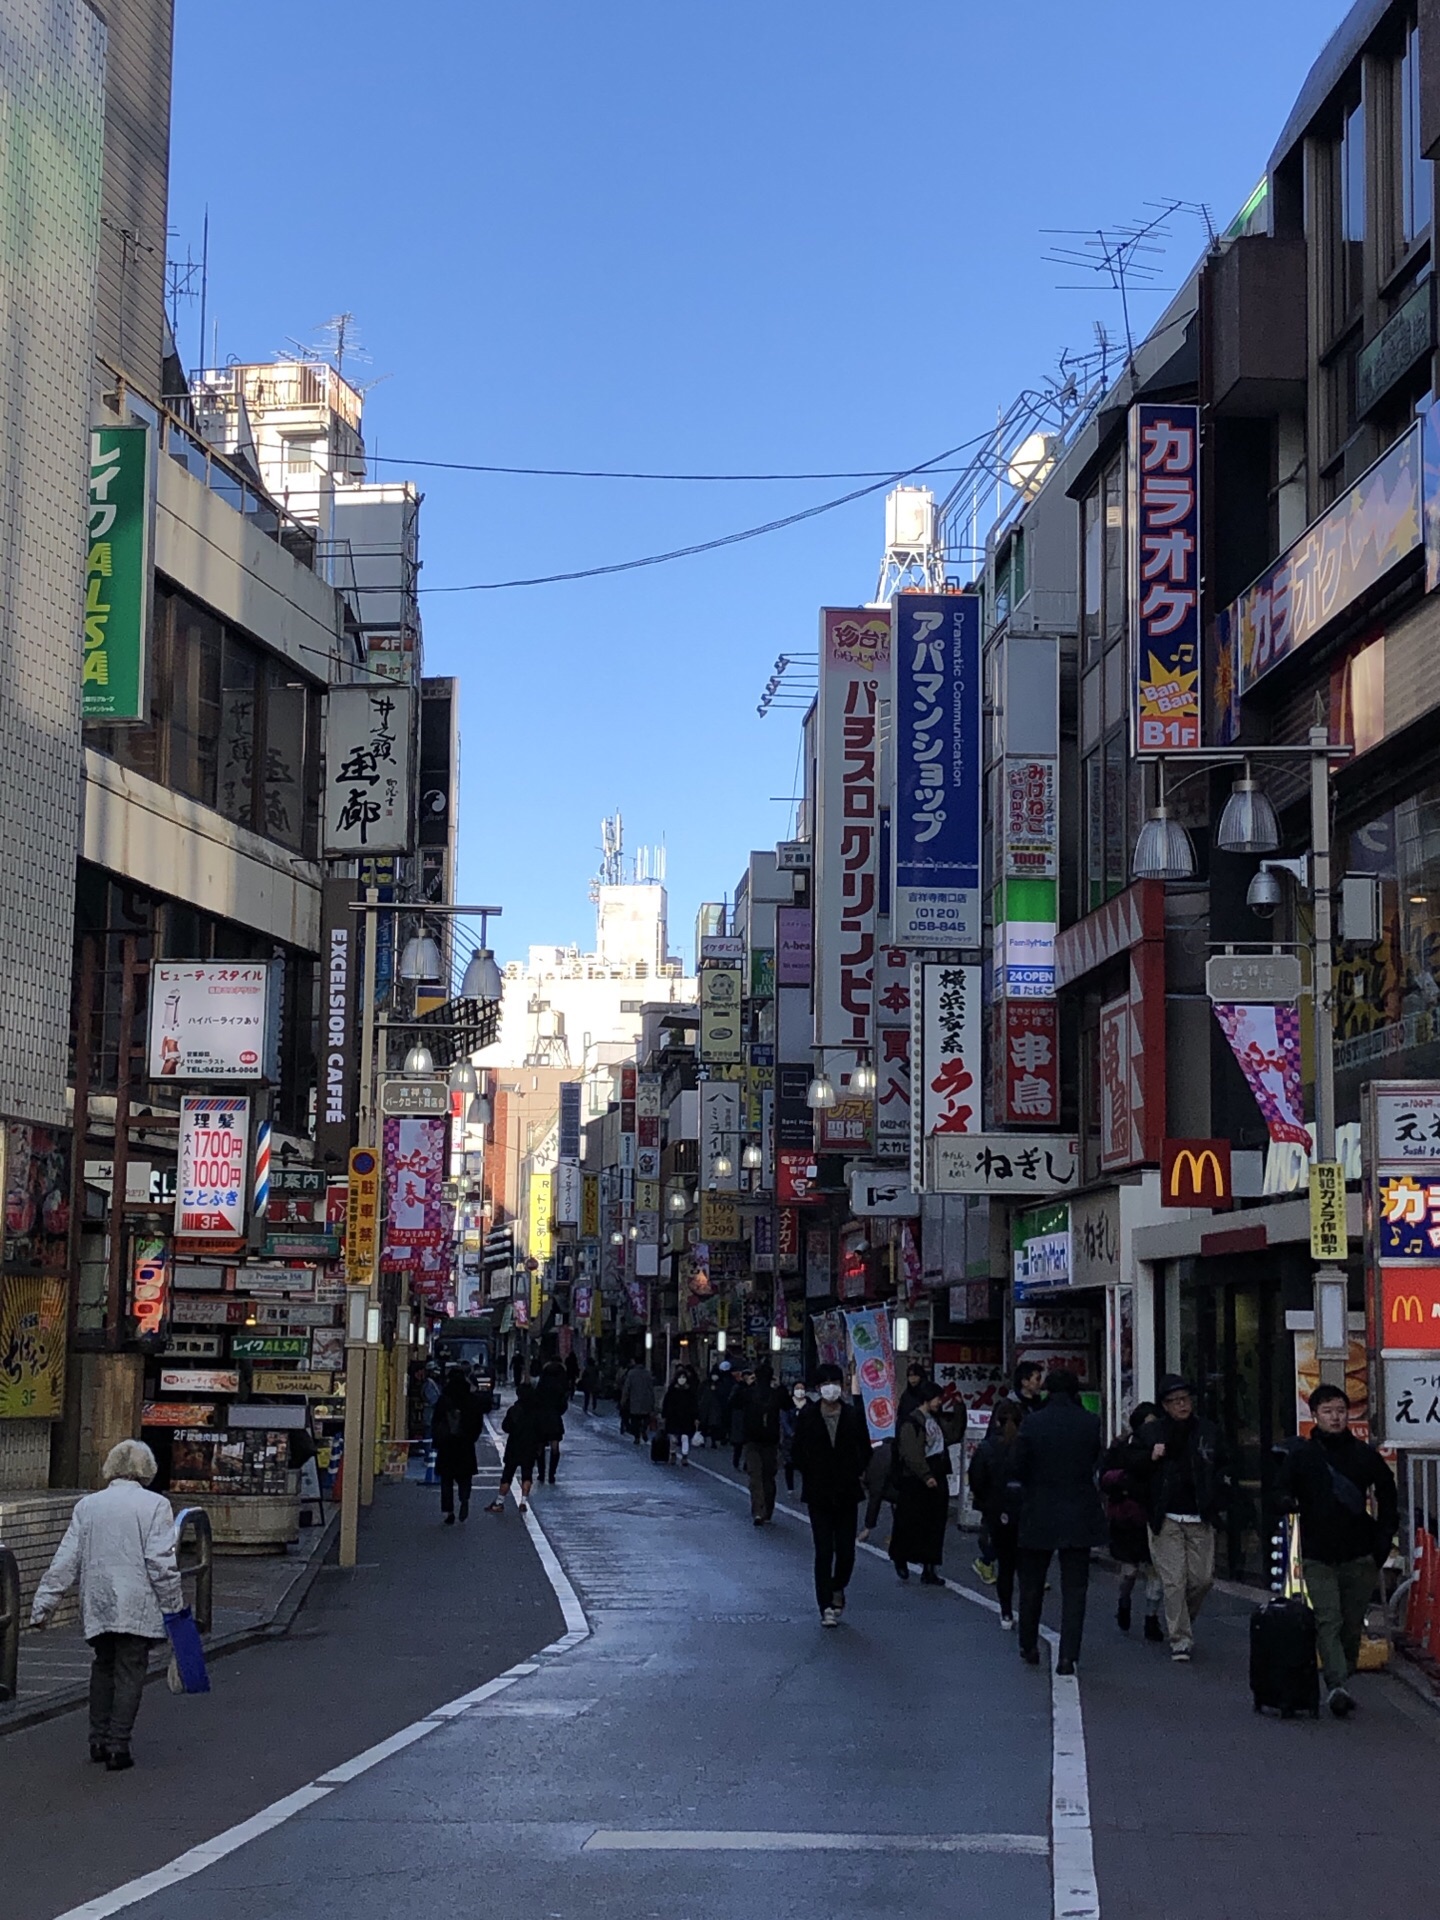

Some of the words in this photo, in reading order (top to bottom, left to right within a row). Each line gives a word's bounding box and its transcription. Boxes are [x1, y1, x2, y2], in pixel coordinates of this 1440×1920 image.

[1141, 420, 1195, 637] カラオケ
[1250, 516, 1347, 673] カラオケ
[952, 612, 966, 678] Dramatic
[1143, 679, 1180, 701] Ban
[1157, 690, 1195, 714] Ban
[912, 610, 948, 843] アパマンショップ
[952, 680, 966, 788] Communication
[1142, 721, 1196, 747] B1F
[1028, 764, 1045, 834] みけねこ
[908, 892, 967, 904] 吉祥寺南口店
[915, 908, 960, 919] (0120)
[909, 920, 967, 932] 058-845
[703, 943, 743, 952] イケダビル
[1009, 938, 1053, 949] FamilyMart
[327, 928, 348, 1047] EXCELSIOR
[1010, 985, 1021, 996] 酒
[1024, 985, 1054, 996] たばこ
[1009, 1030, 1053, 1117] 串鳥
[325, 1059, 347, 1125] CAFFÉ
[400, 1087, 432, 1097] 吉祥寺
[193, 1113, 236, 1130] 理髪
[827, 1120, 864, 1140] 聖地
[194, 1131, 243, 1159] 1700円
[1403, 1144, 1428, 1157] Sushi
[192, 1160, 241, 1189] 1000円
[974, 1145, 1075, 1185] ねぎし
[182, 1190, 239, 1207] ことぶき
[200, 1214, 221, 1230] 3F
[1318, 1167, 1338, 1256] 防犯カメラ作動中
[233, 1339, 299, 1353] レイクALSA
[22, 1389, 37, 1407] 3F
